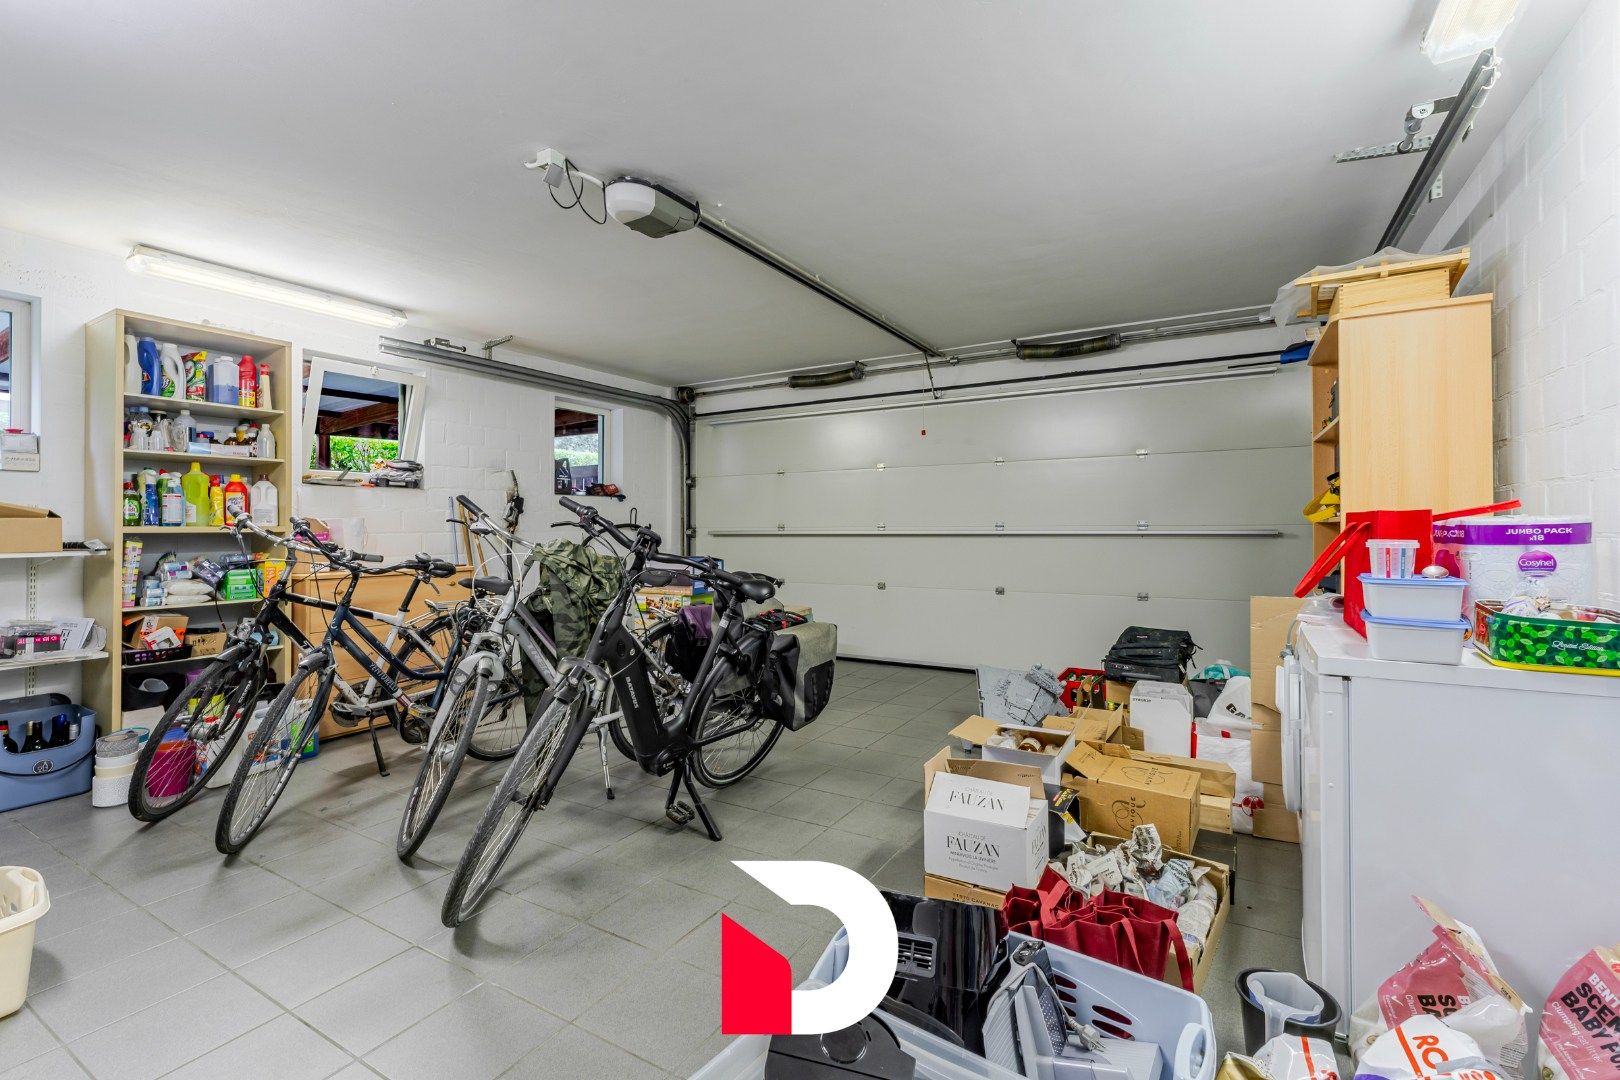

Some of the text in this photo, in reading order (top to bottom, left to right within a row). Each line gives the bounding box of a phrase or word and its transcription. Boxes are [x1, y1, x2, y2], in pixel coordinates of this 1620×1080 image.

[1505, 527, 1573, 535] JUMBO PACK
[1529, 534, 1545, 542] x18
[625, 676, 640, 709] BATAVUS
[949, 790, 1005, 811] FAUZAN
[947, 835, 1000, 858] FAUZAN
[1552, 1000, 1581, 1036] Clumping
[1560, 991, 1613, 1039] BABY
